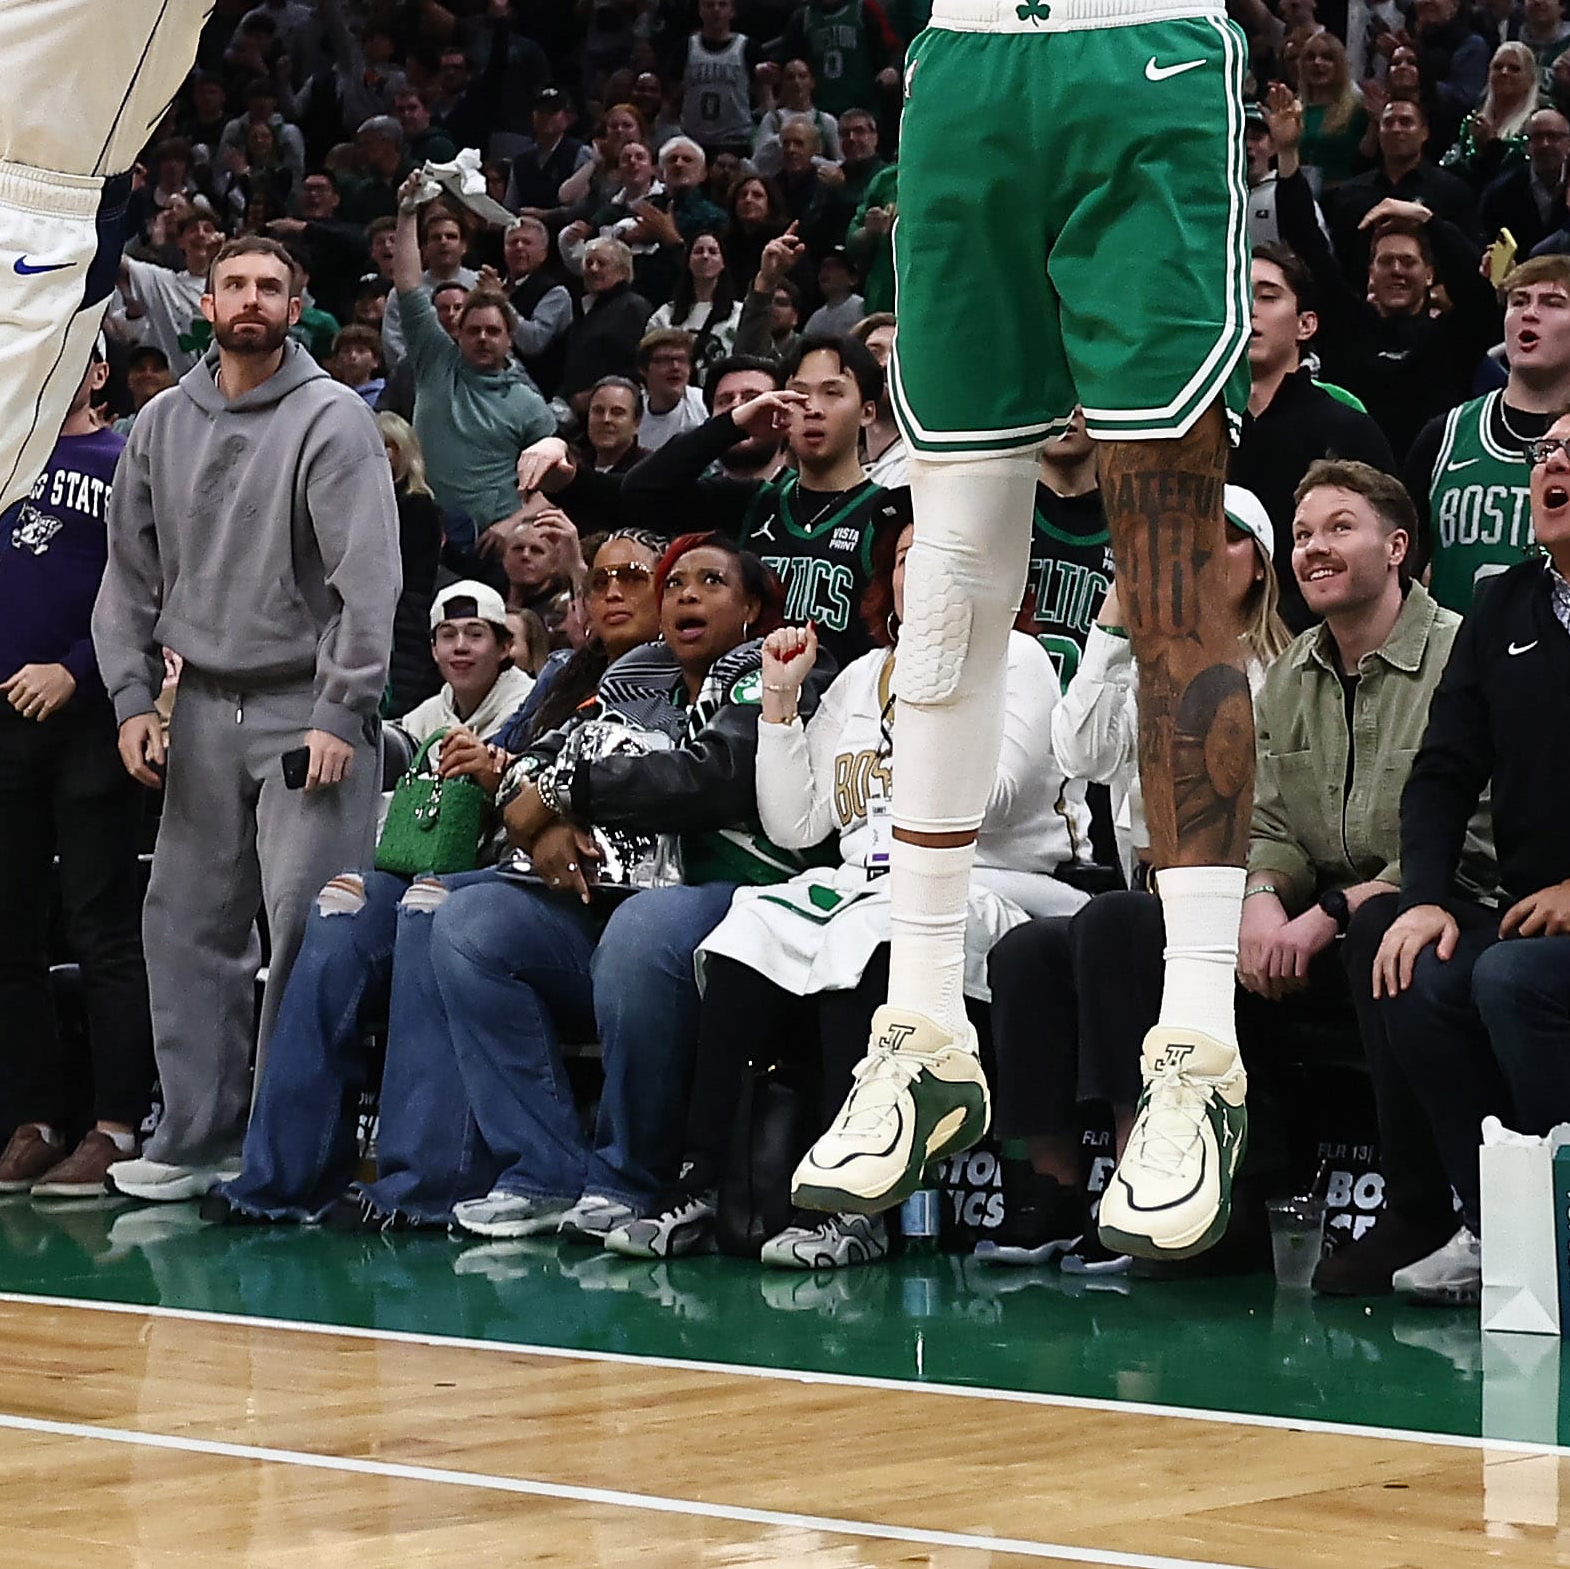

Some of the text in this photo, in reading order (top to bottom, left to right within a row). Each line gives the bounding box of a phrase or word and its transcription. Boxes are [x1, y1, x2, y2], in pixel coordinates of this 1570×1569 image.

[1439, 484, 1534, 550] BOST
[832, 527, 860, 542] VISTA
[828, 539, 858, 553] PRINT
